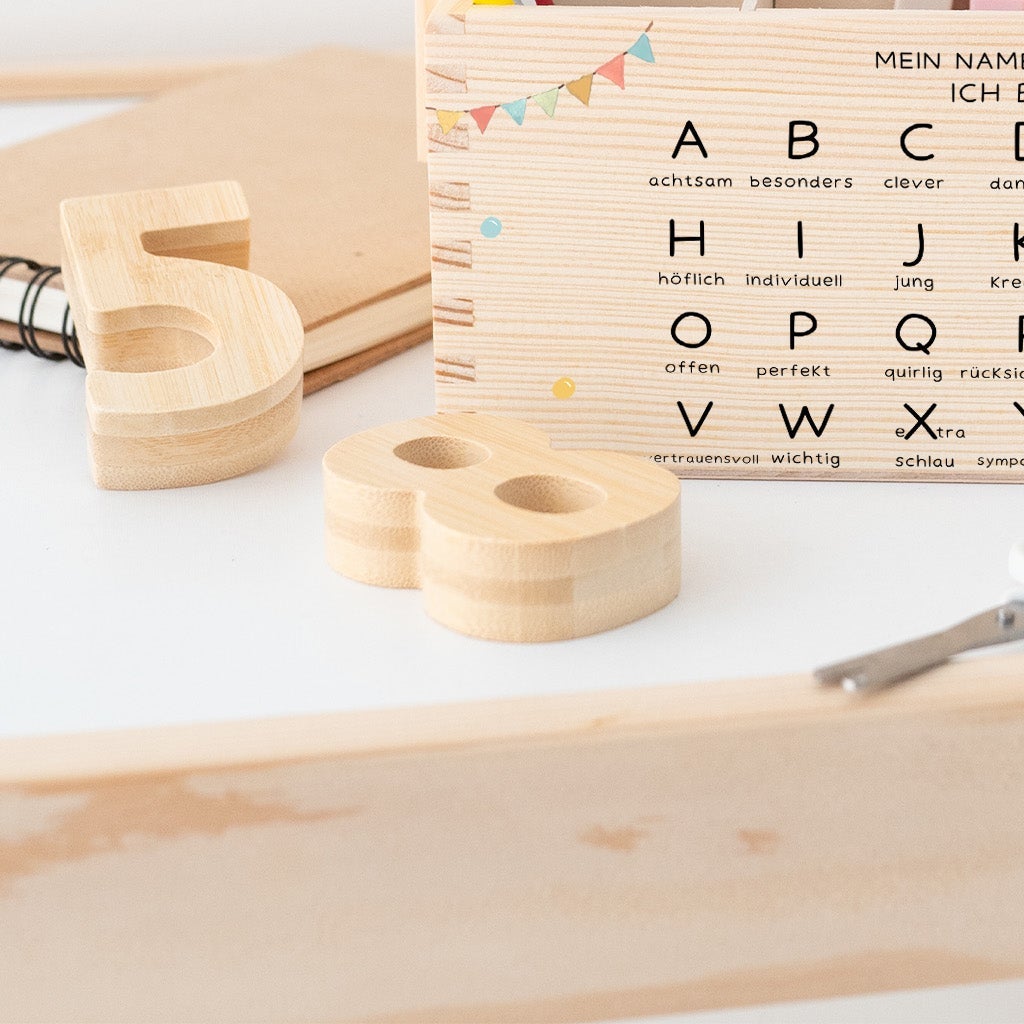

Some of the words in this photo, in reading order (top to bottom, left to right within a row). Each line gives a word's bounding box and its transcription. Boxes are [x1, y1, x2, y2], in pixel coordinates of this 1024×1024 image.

[875, 51, 941, 70] MEIN
[951, 82, 1000, 103] ICH
[671, 120, 708, 160] A
[787, 119, 820, 160] B
[899, 123, 935, 162] C
[648, 173, 733, 188] achtsam
[750, 175, 853, 189] besonders
[883, 176, 944, 190] clever
[669, 218, 705, 258] H
[797, 220, 804, 259] I
[902, 223, 925, 268] J
[657, 271, 725, 286] höflich
[745, 273, 842, 287] individuell
[893, 275, 934, 292] jung
[60, 180, 304, 490] 5
[670, 311, 713, 349] O
[789, 310, 818, 351] P
[895, 313, 937, 356] Q
[664, 360, 720, 374] offen
[884, 366, 943, 383] quirlig
[676, 400, 714, 438] V
[779, 403, 835, 440] W
[650, 453, 759, 465] ertrauensvoll
[771, 450, 840, 469] wichtig
[895, 454, 955, 468] schlau
[322, 412, 682, 642] 8
